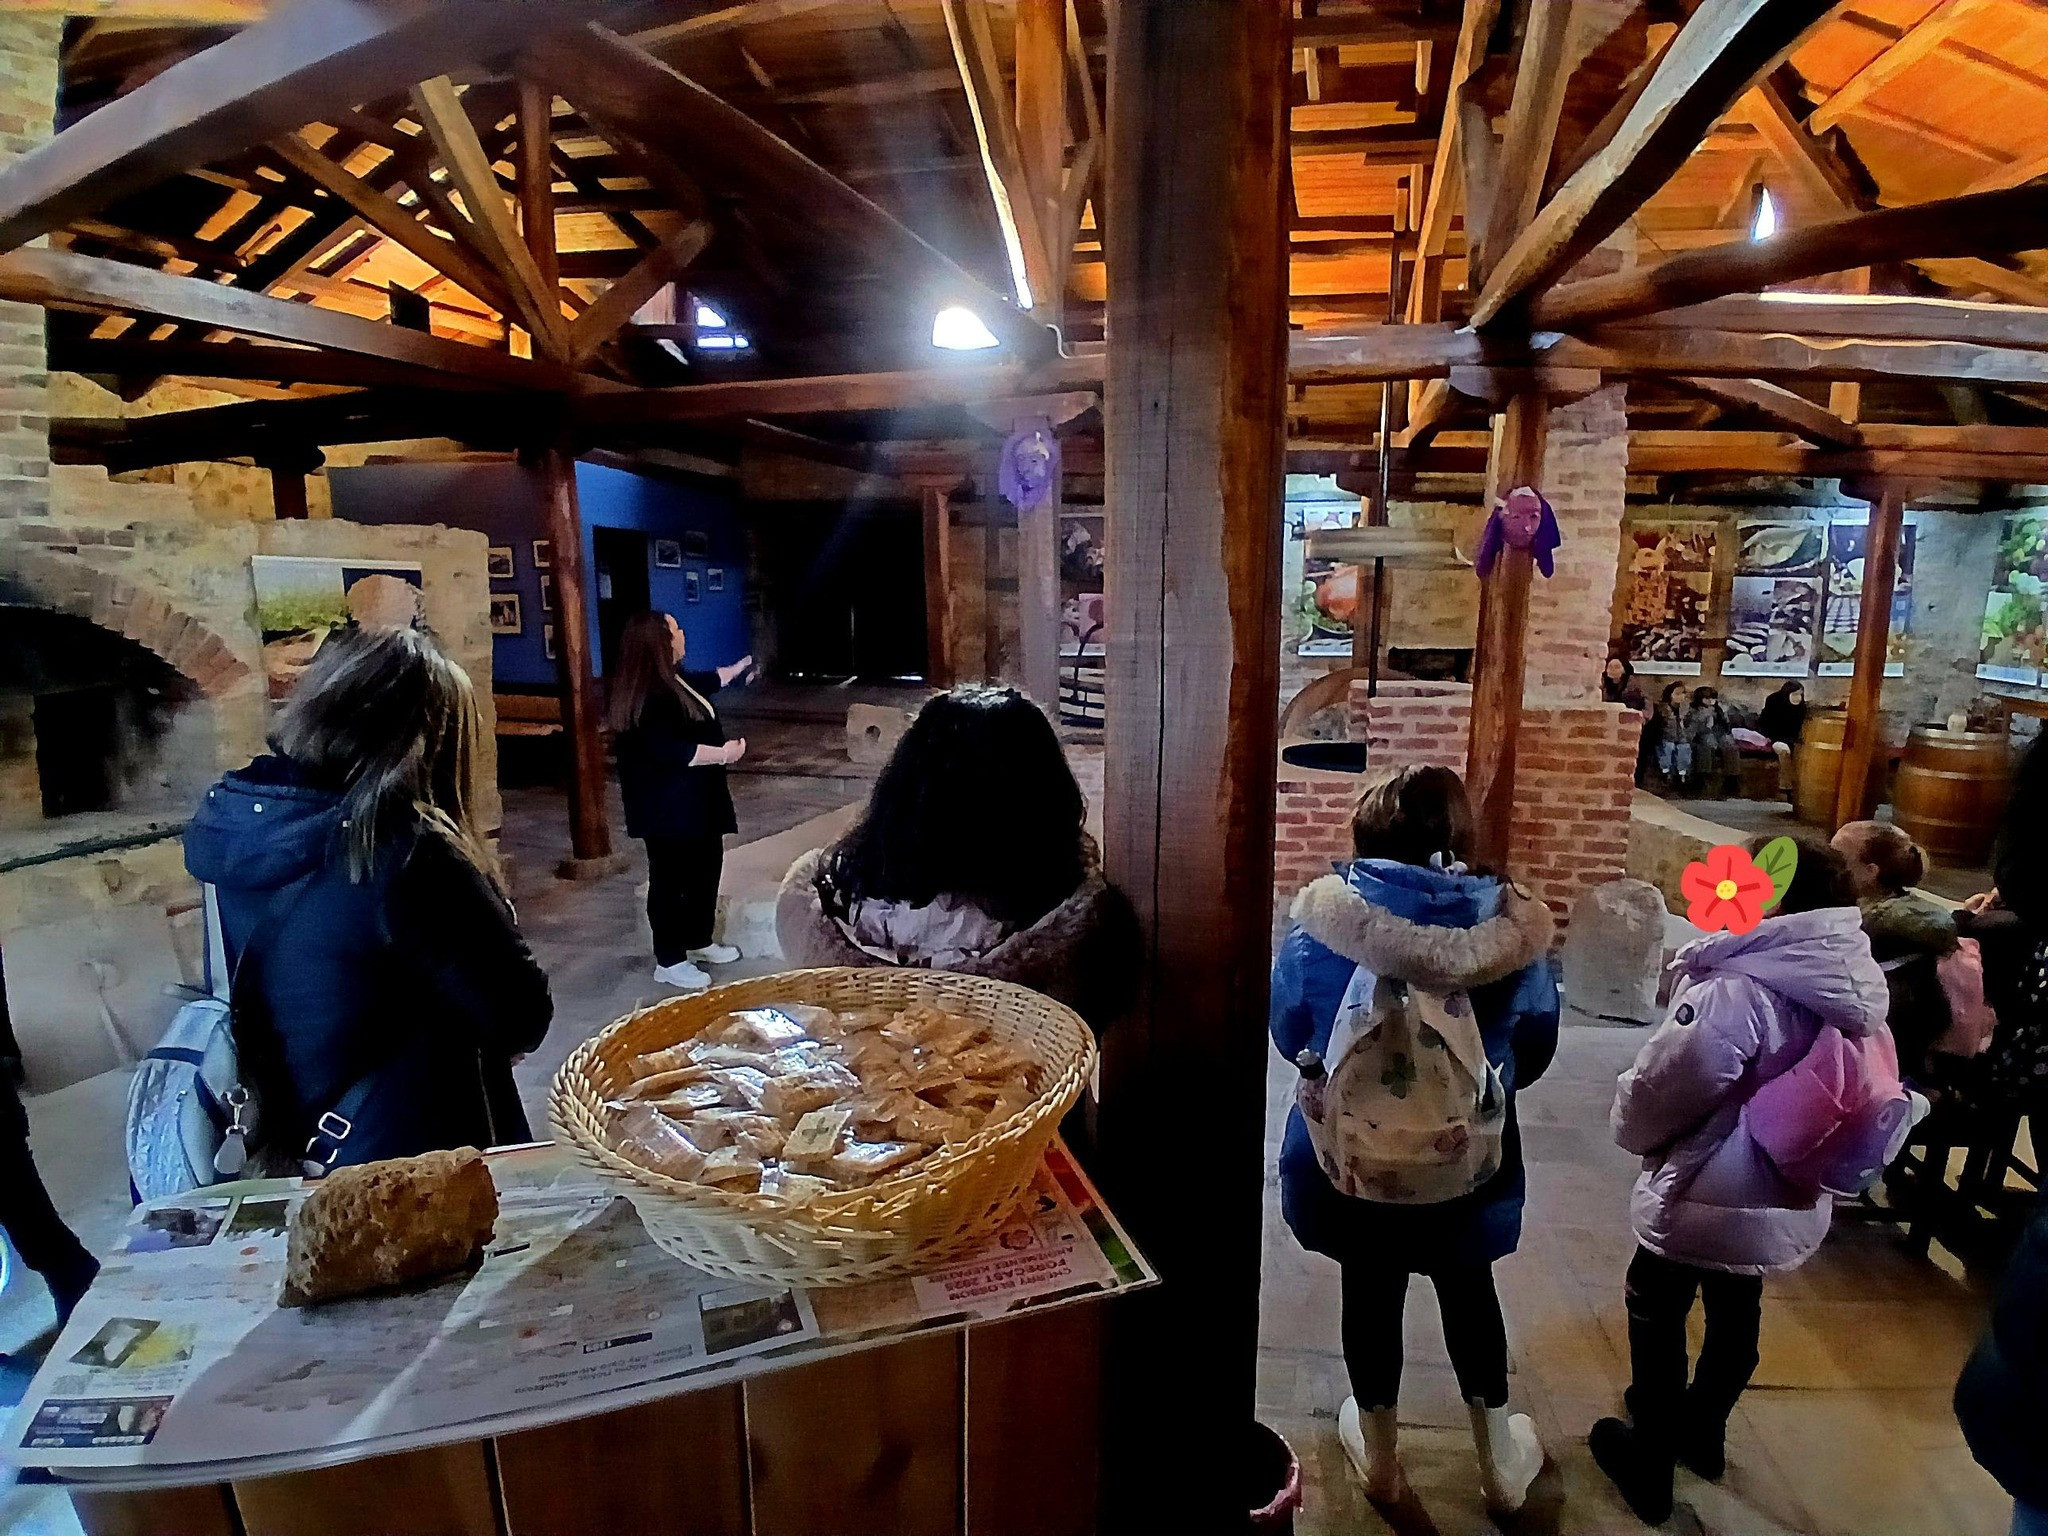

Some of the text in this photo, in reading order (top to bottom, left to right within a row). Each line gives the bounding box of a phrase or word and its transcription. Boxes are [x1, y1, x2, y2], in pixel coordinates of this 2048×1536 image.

[949, 1267, 1072, 1300] CHERRY BLOSSOM
[986, 1258, 1066, 1283] FORECAST
